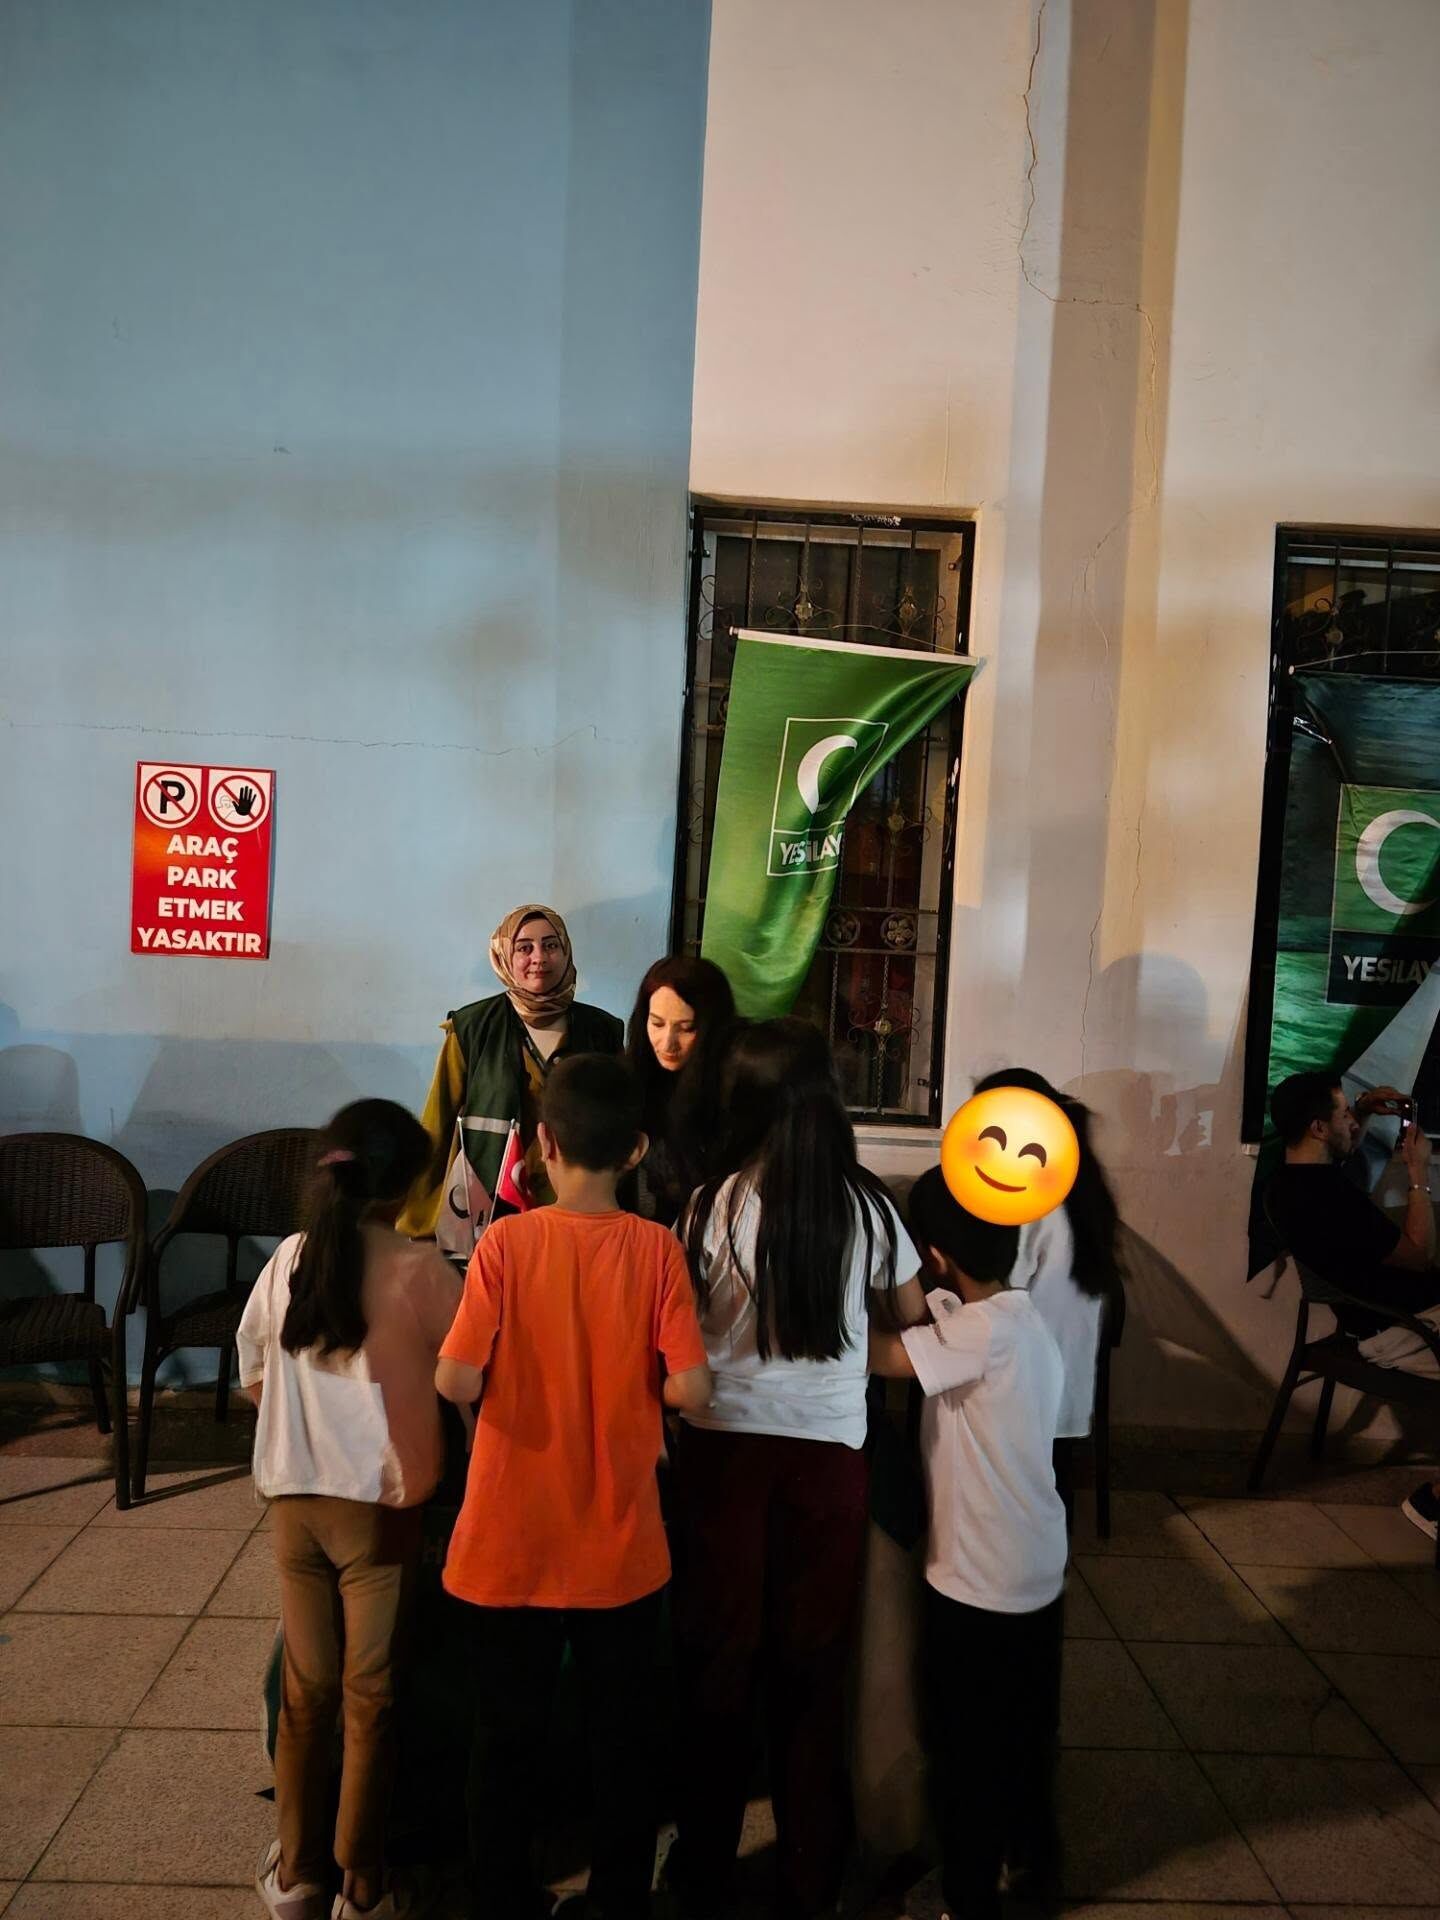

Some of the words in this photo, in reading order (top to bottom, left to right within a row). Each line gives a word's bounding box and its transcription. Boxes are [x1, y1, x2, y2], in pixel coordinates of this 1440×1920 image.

[167, 834, 239, 863] ARAÇ
[780, 832, 843, 865] YEŞİLAY
[167, 866, 237, 890] PARK
[158, 897, 244, 921] ETMEK
[137, 927, 261, 953] YASAKTIR
